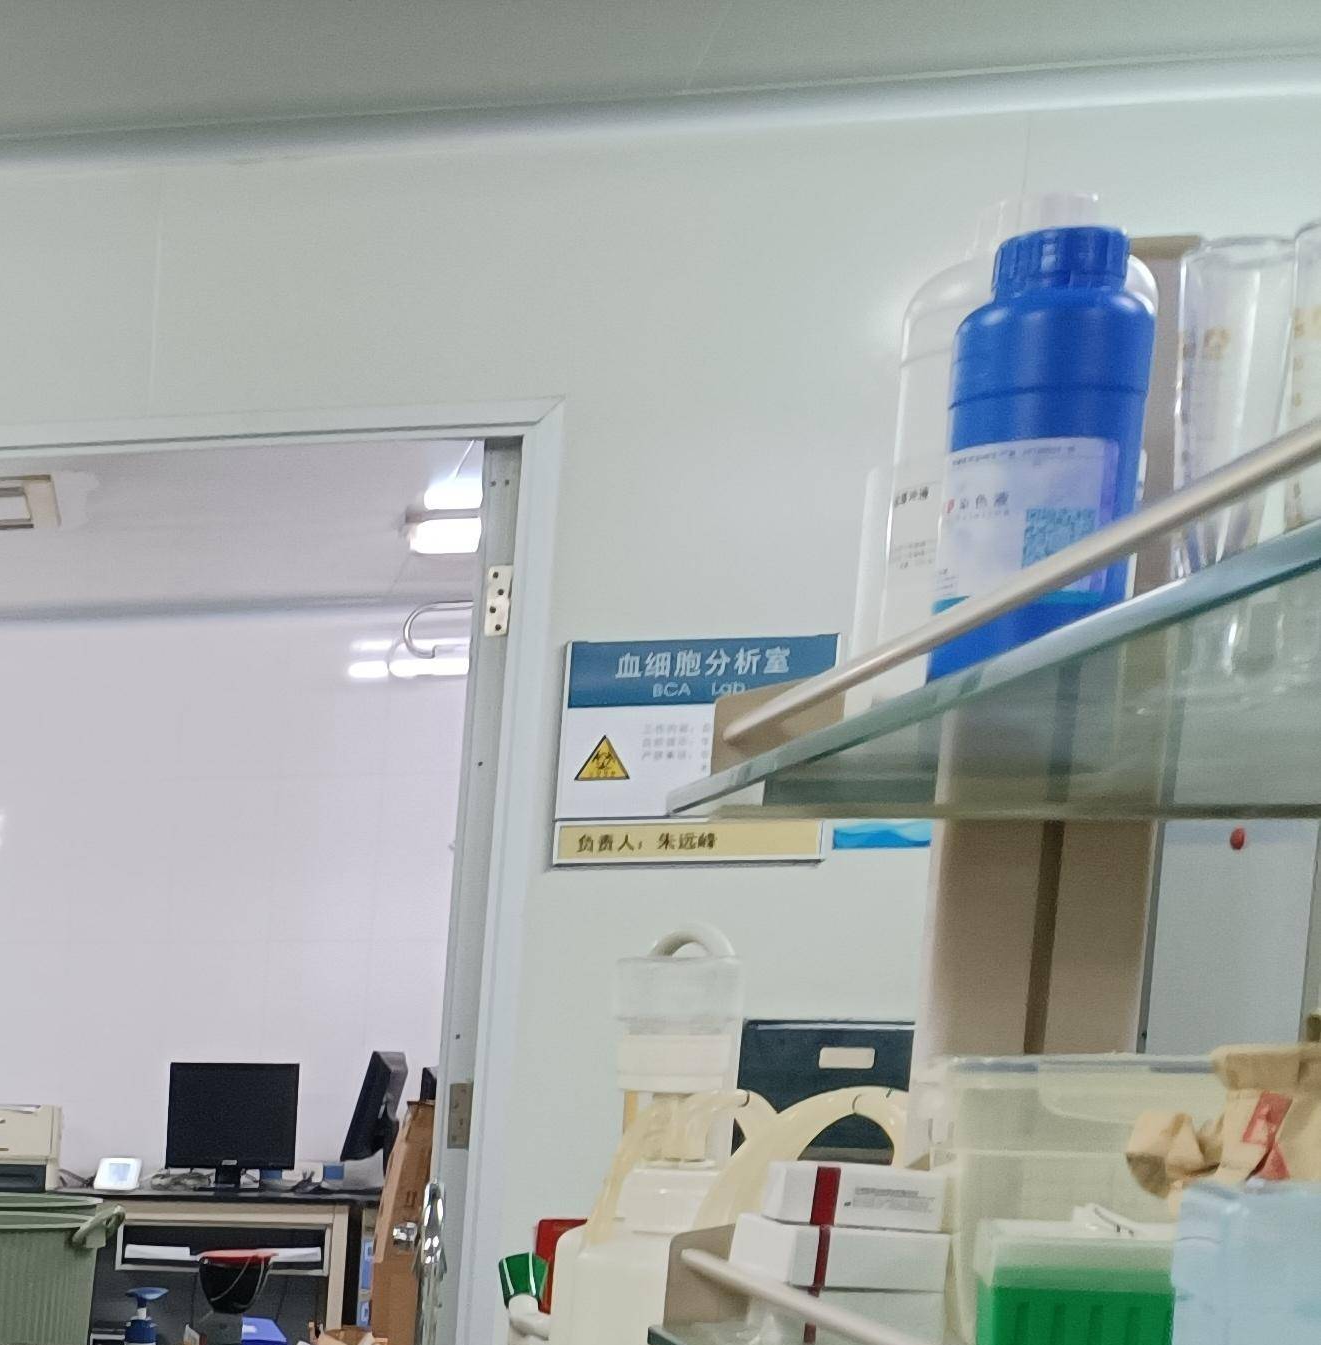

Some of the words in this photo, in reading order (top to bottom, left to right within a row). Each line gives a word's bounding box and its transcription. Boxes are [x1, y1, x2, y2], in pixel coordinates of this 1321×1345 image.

[614, 646, 791, 679] 血细胞分析室
[652, 682, 691, 698] BCA
